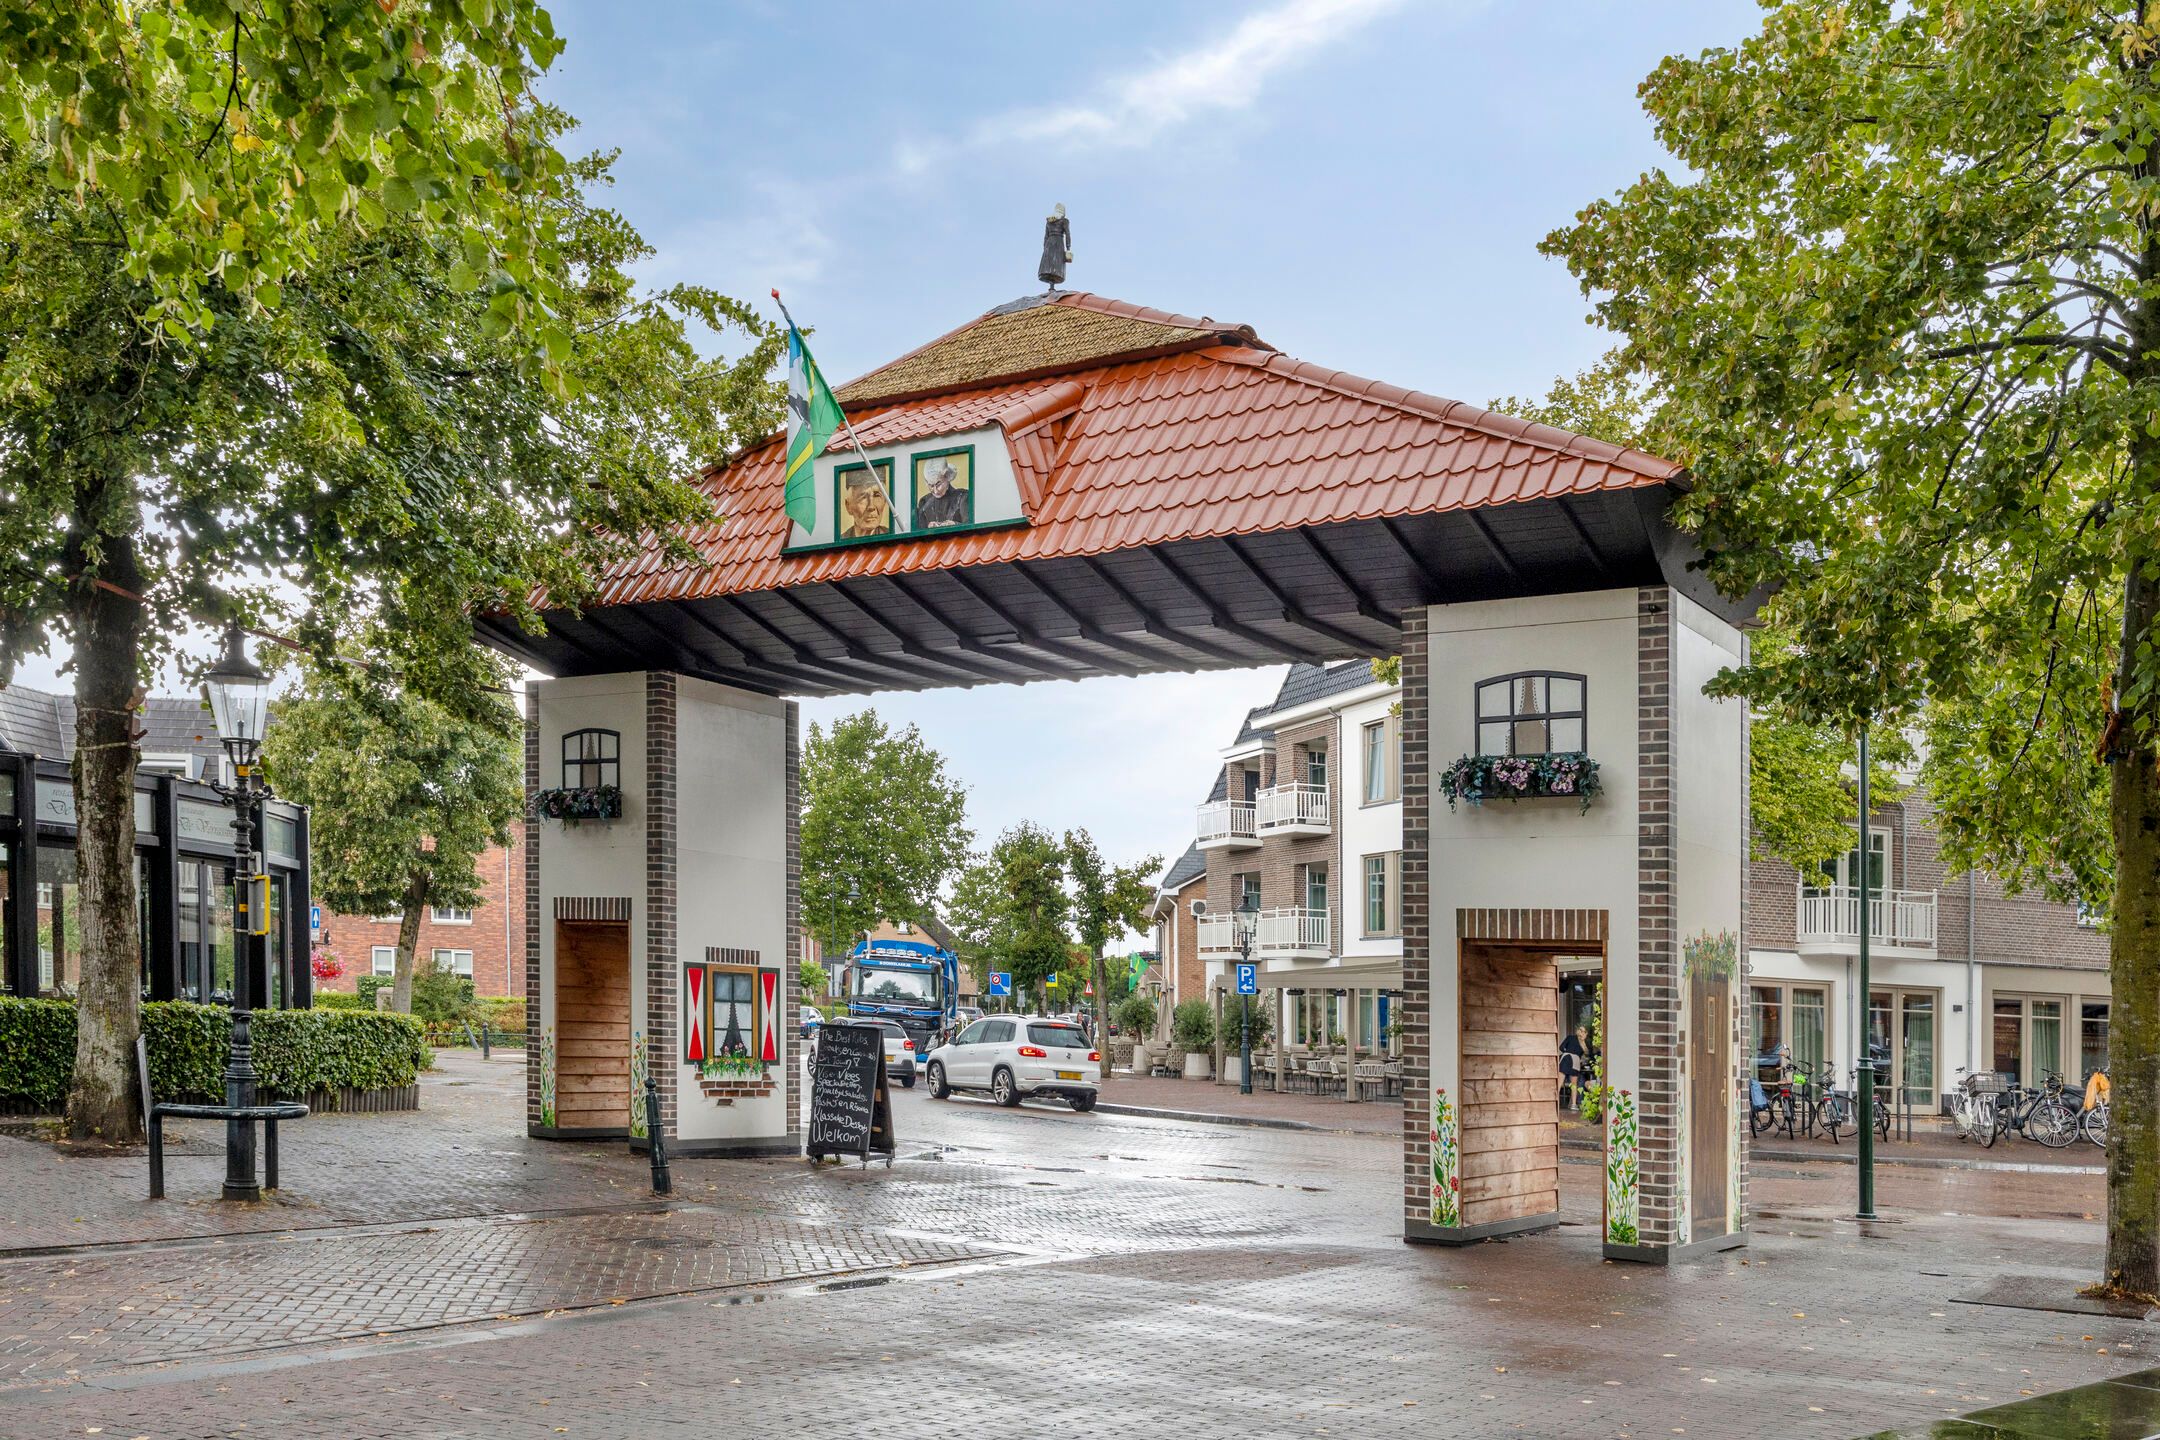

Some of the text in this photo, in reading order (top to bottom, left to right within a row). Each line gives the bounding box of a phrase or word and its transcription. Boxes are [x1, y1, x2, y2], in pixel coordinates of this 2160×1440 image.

[1241, 966, 1252, 982] P
[820, 1029, 834, 1041] The
[838, 1068, 861, 1083] Vlees
[812, 1122, 861, 1149] Welkom
